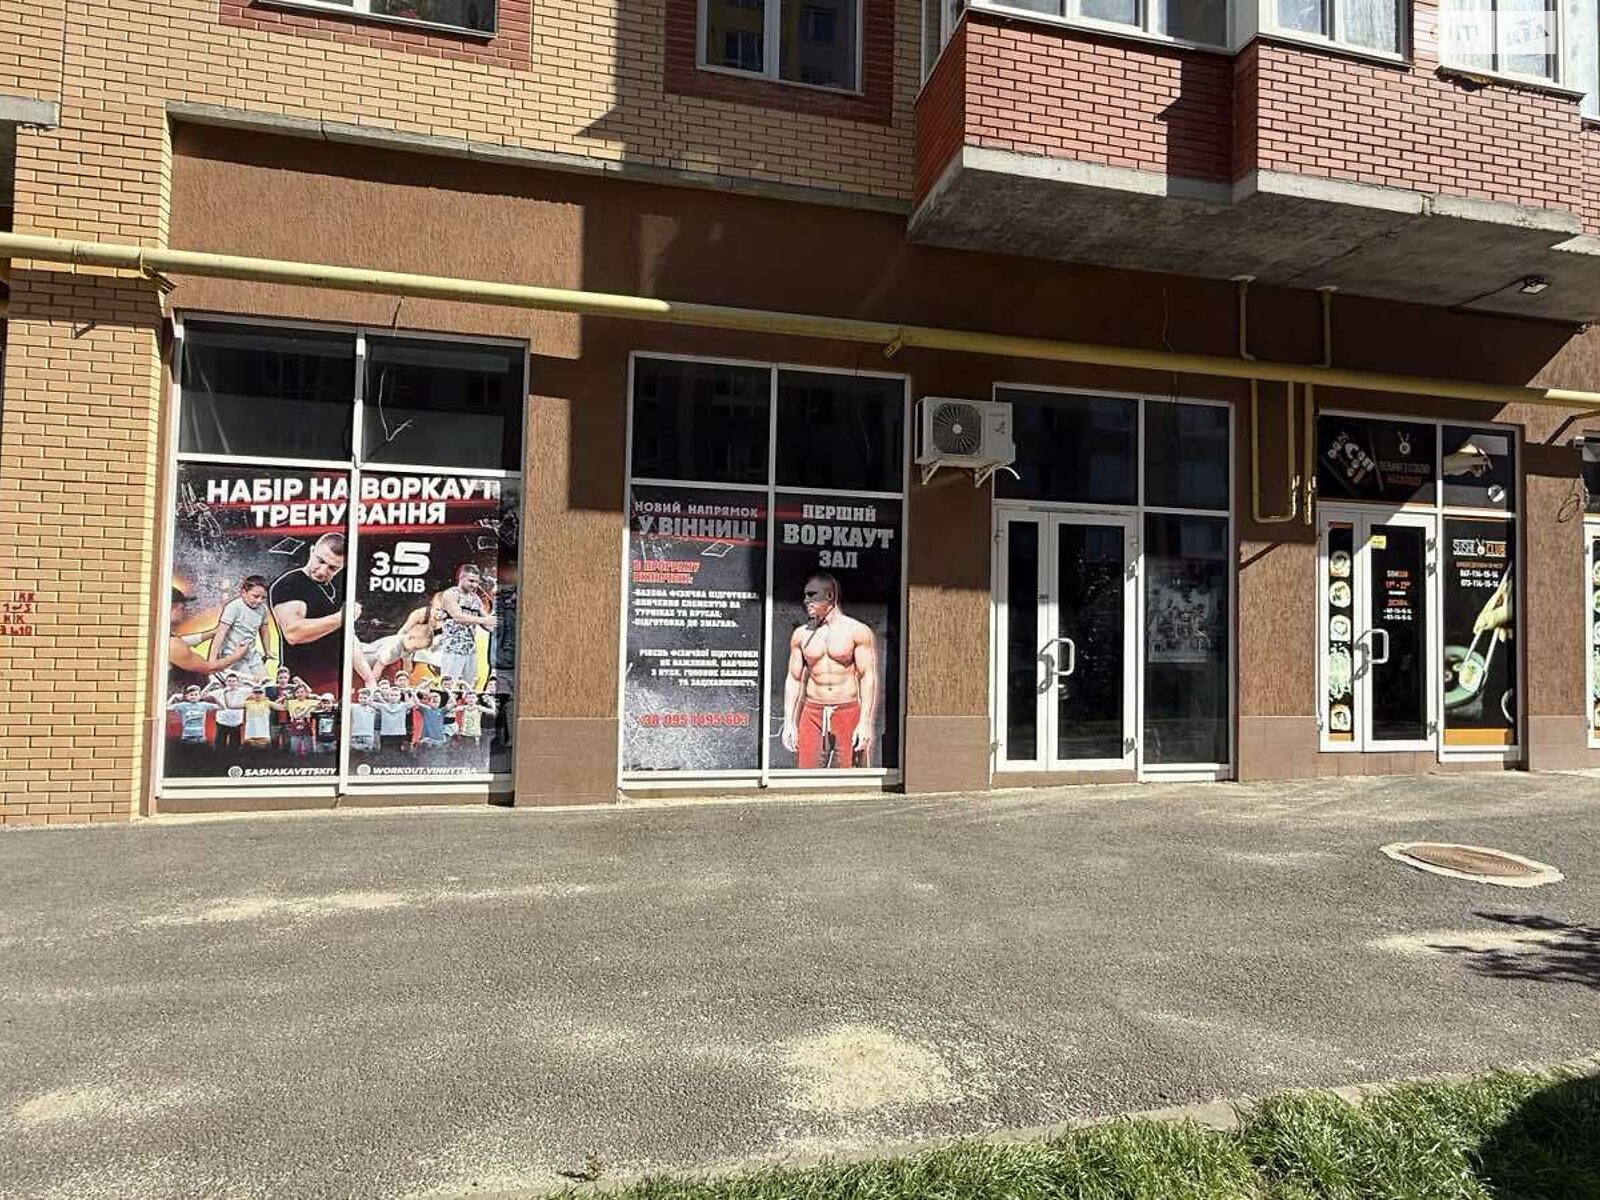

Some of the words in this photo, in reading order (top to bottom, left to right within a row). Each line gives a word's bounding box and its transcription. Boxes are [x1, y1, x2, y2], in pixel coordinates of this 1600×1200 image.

[207, 478, 303, 502] НАБІР
[310, 477, 349, 500] НА
[361, 477, 499, 500] ВОРКАУТ
[251, 503, 446, 527] ТРЕНУВАННЯ
[634, 501, 681, 514] НОВИЙ
[688, 504, 758, 518] НАПРЯМОК
[802, 503, 877, 522] ПЕРШИЙ
[638, 514, 654, 536] У
[658, 516, 757, 541] ВІННИЦІ
[783, 524, 895, 548] ВОРКАУТ
[393, 542, 431, 575] 5
[819, 550, 859, 568] ЗАЛ
[369, 577, 426, 593] РОКІВ
